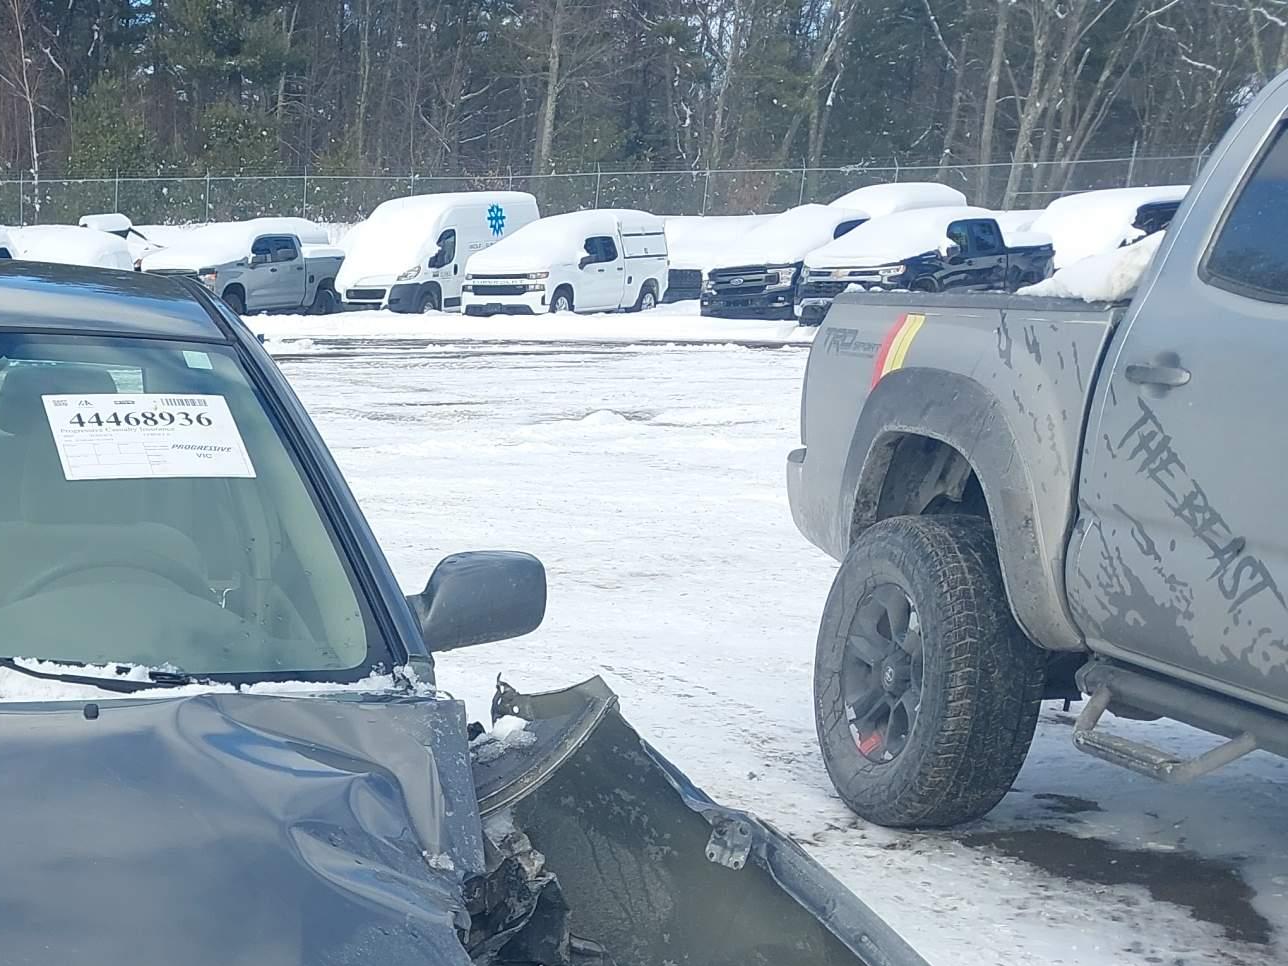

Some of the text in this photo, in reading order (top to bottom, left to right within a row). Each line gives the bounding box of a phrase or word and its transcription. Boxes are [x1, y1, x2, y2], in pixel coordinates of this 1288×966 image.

[69, 411, 213, 427] 44468936
[171, 444, 232, 453] PROGRESSIVE
[1117, 395, 1288, 614] THE BEAST
